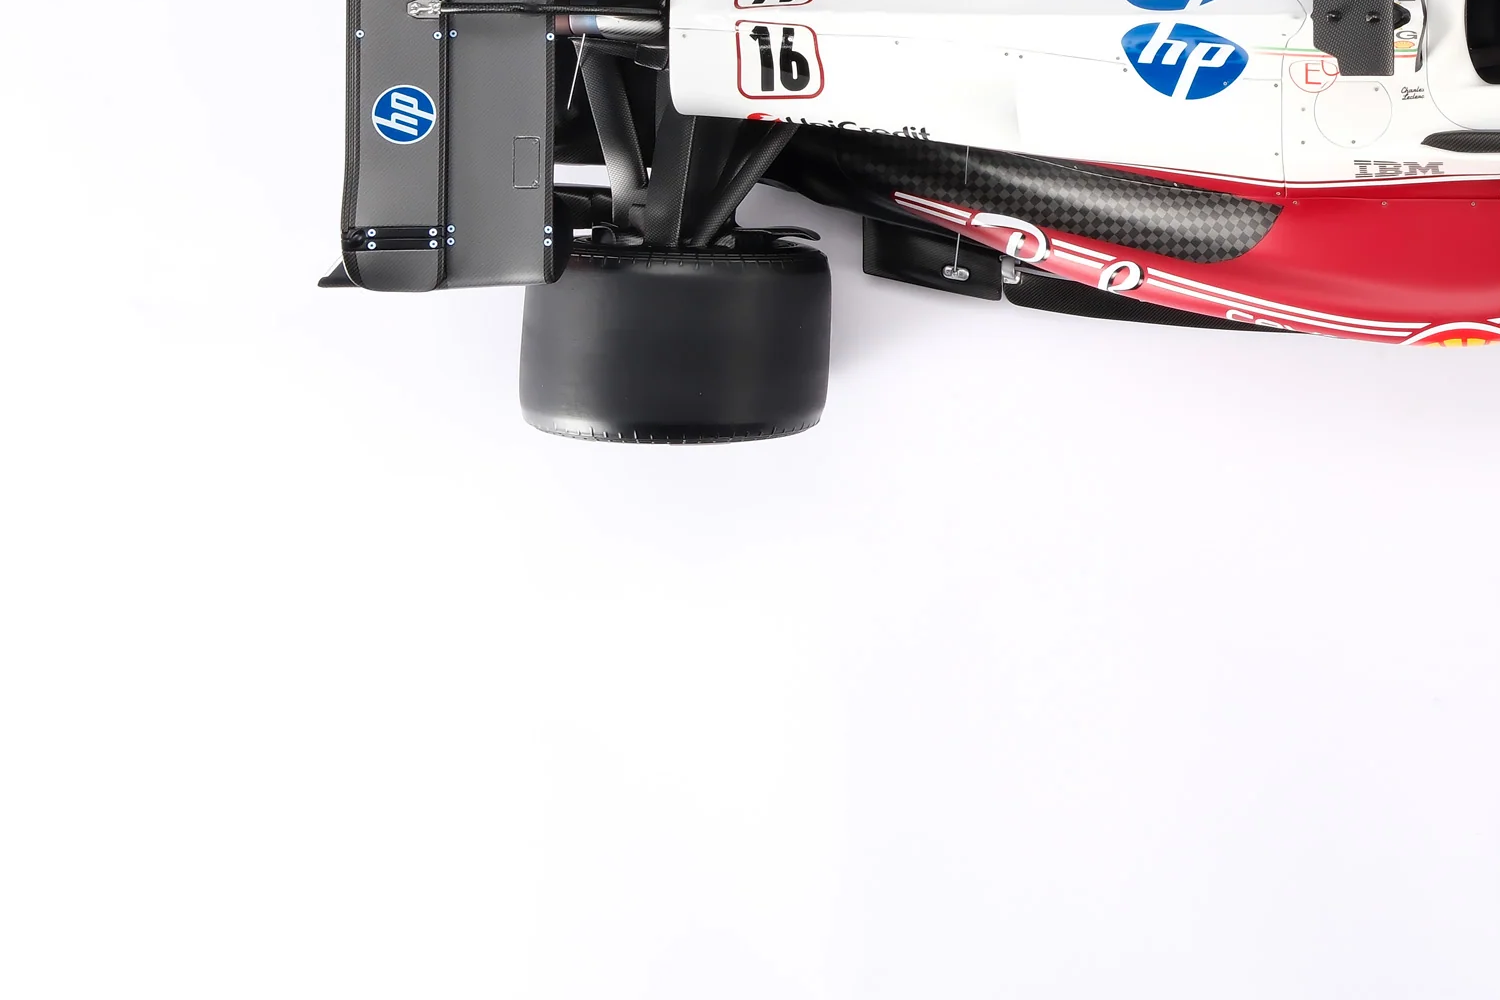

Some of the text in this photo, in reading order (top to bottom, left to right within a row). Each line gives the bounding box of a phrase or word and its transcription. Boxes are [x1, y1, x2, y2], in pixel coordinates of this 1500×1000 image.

[749, 26, 811, 92] 16
[1138, 22, 1236, 100] hp
[1305, 63, 1322, 84] E
[373, 91, 436, 137] hp
[1353, 159, 1445, 179] IBM
